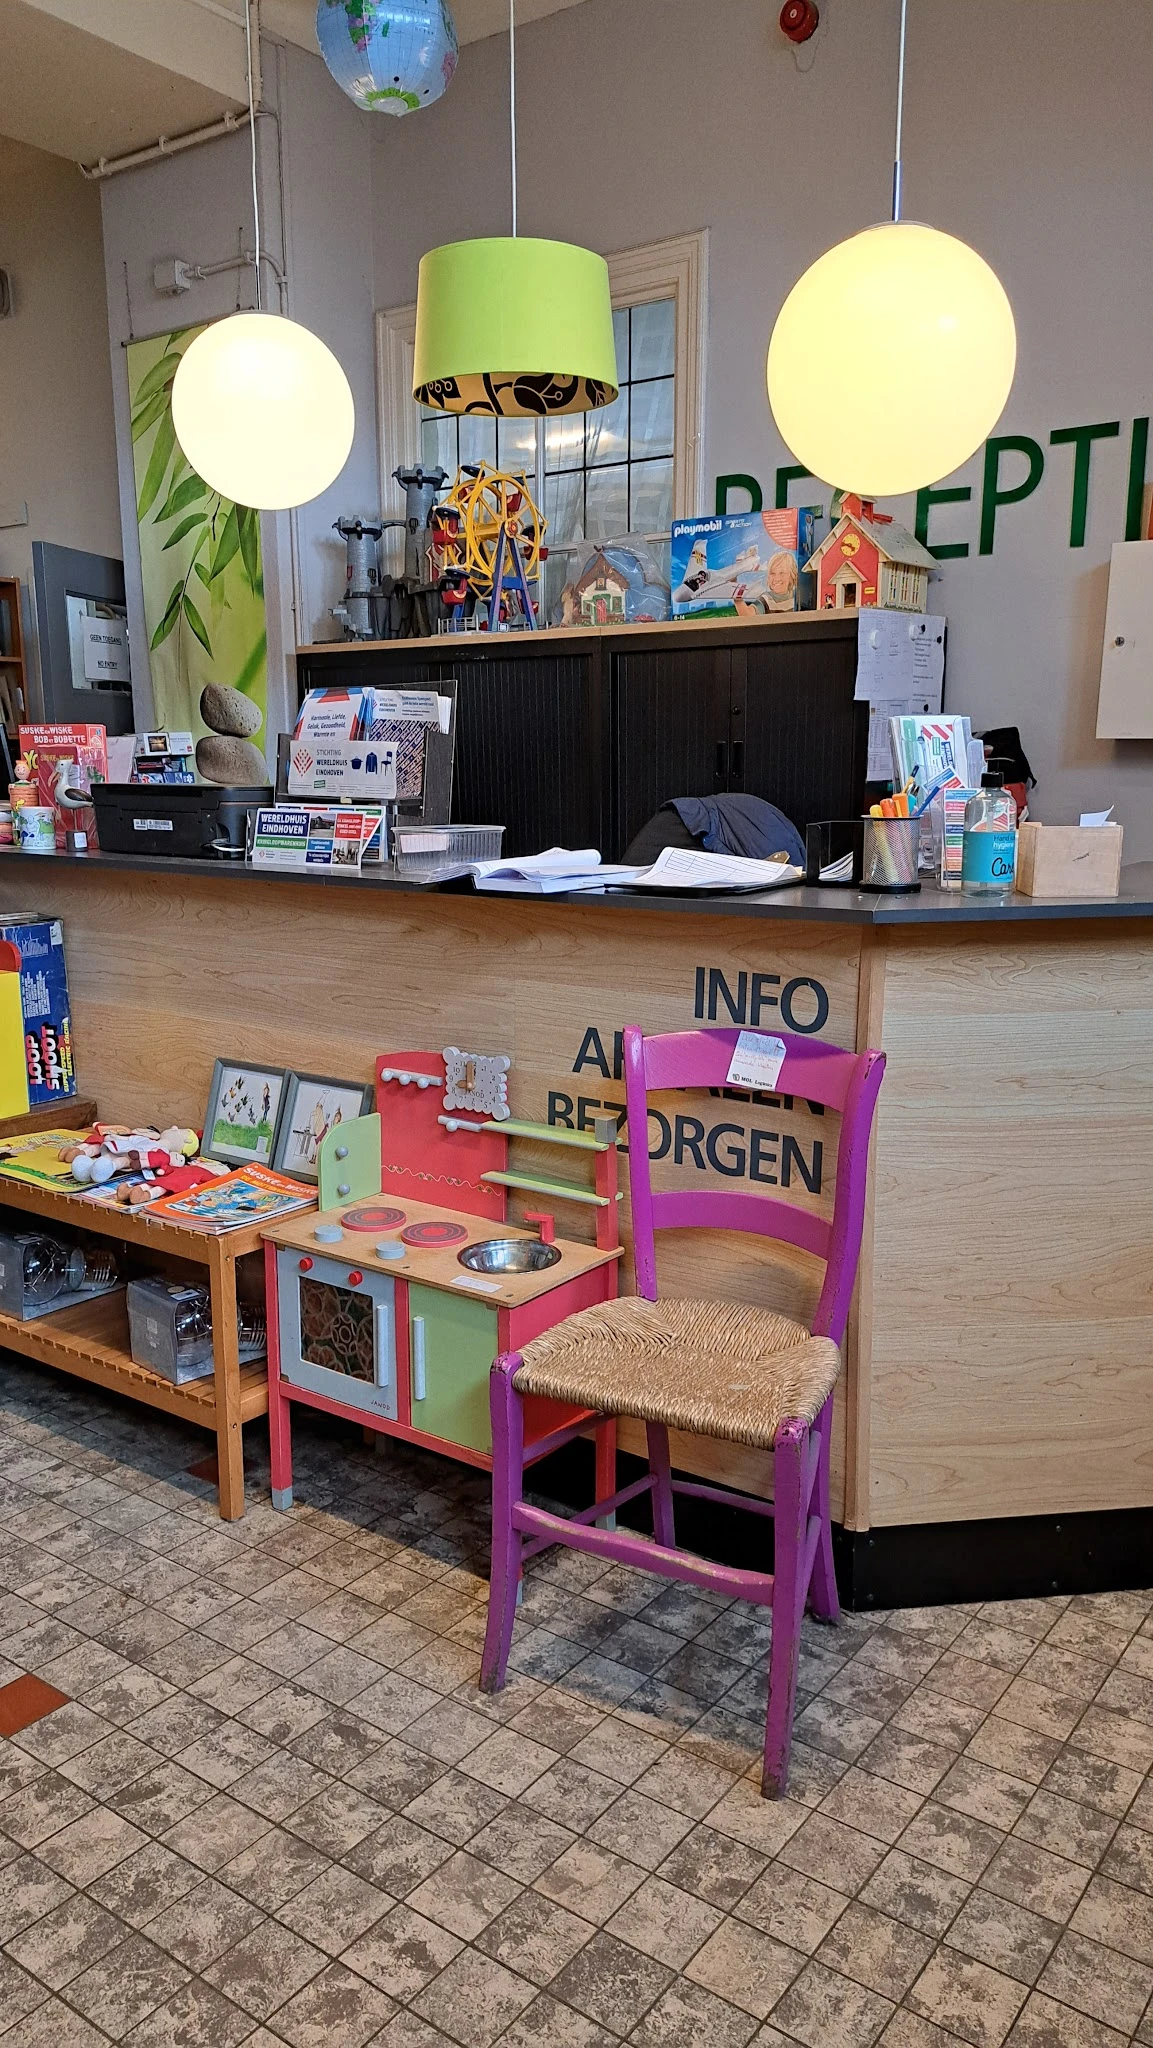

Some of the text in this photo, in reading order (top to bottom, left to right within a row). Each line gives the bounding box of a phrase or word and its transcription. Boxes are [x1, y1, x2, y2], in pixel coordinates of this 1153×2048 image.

[674, 520, 722, 537] playmobil
[90, 634, 102, 642] GEEN
[98, 660, 117, 669] NO ENTRY
[20, 727, 45, 735] SUSKE
[49, 726, 73, 734] WISKE
[34, 735, 49, 744] BOB
[53, 735, 86, 744] BOBETTE
[316, 759, 348, 767] WERELDHUIS
[261, 813, 307, 825] WERELDHUIS
[262, 824, 303, 834] EINDHOVEN
[694, 966, 829, 1034] INFO
[25, 1034, 43, 1086] LOOP
[41, 1025, 61, 1091] SHOOT
[243, 1167, 282, 1186] SUSKE
[284, 1183, 319, 1196] WISKE
[370, 1399, 391, 1411] JANOD
